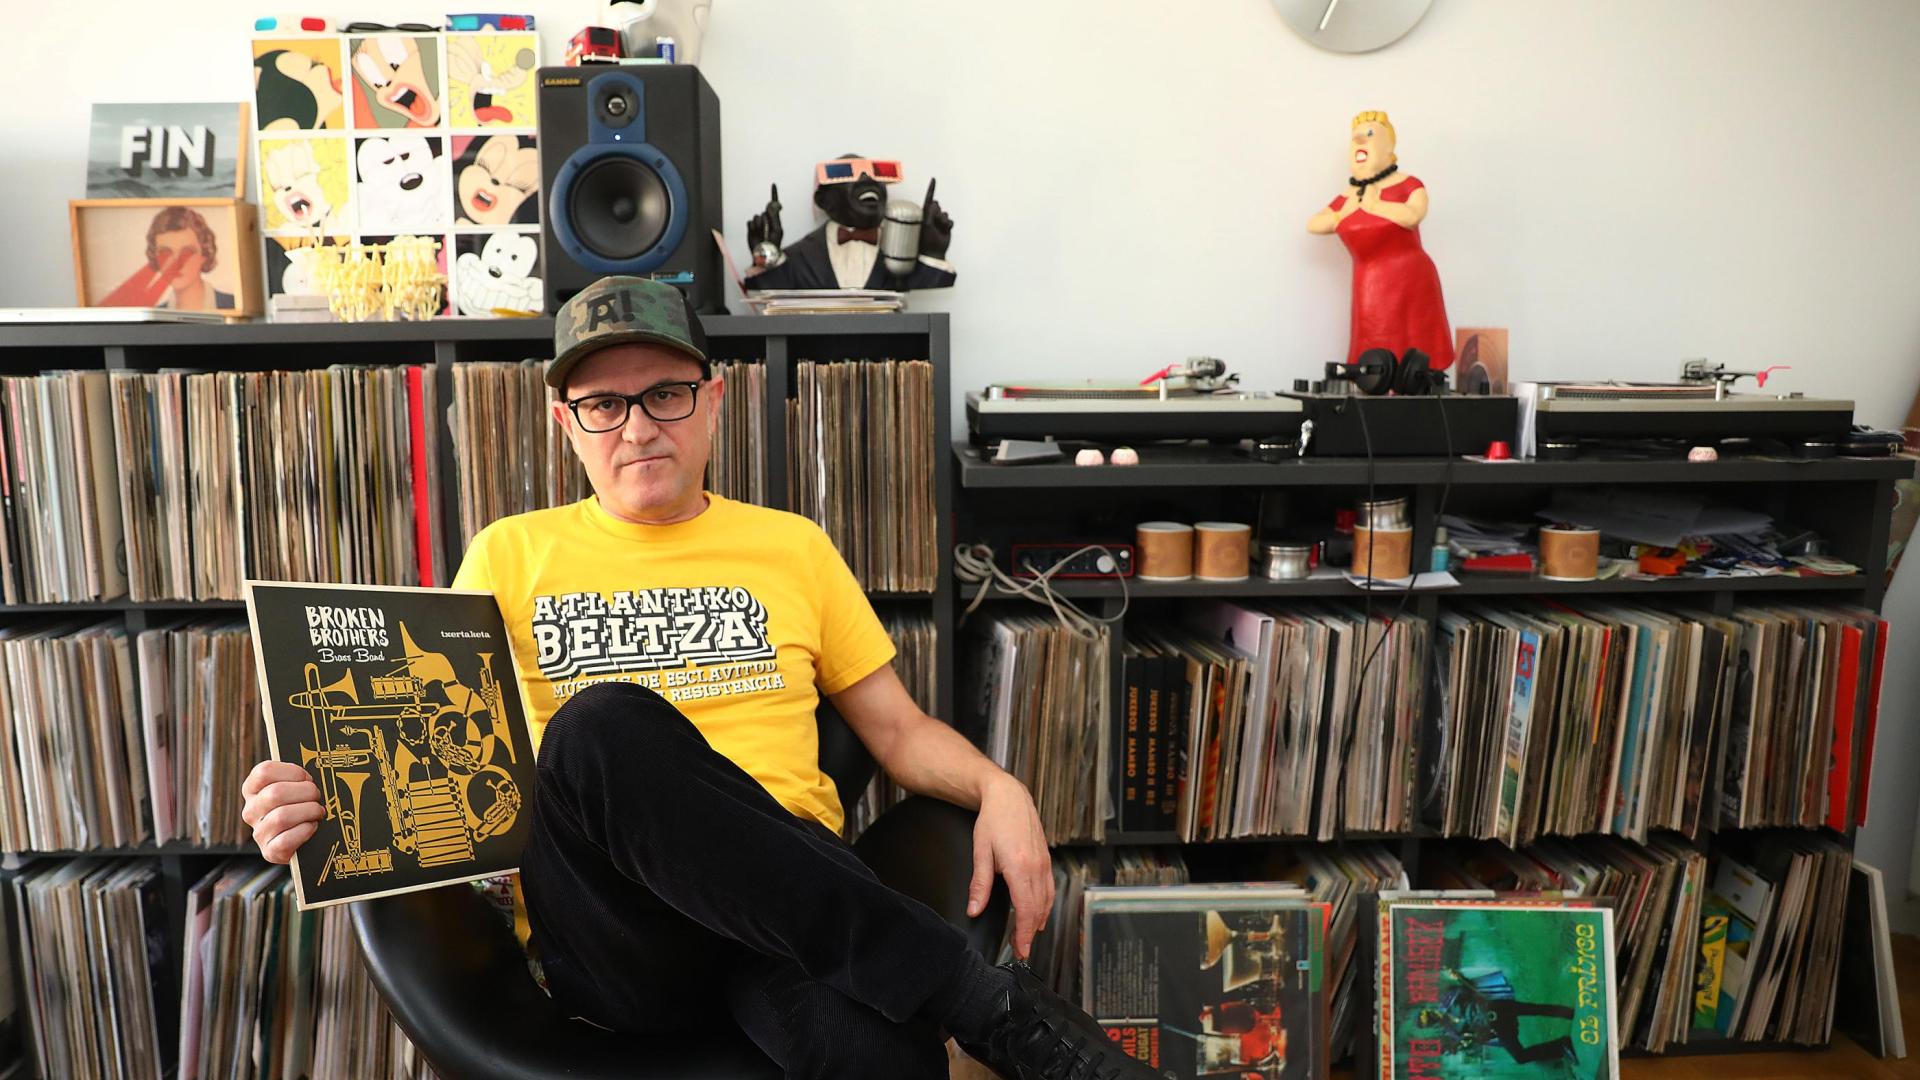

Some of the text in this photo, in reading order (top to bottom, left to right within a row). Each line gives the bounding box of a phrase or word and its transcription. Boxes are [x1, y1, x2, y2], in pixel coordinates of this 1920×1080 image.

[120, 125, 214, 176] FIN
[304, 605, 386, 629] BROKEN
[532, 586, 760, 622] ATLANTIKO
[308, 627, 390, 648] BROTHERS
[440, 630, 491, 640] txertaketa
[533, 611, 768, 670] BELTZA
[317, 648, 385, 663] Brass Band
[638, 673, 661, 689] DE
[671, 673, 785, 702] RESISTENCIA
[1137, 1027, 1149, 1060] CUGAT
